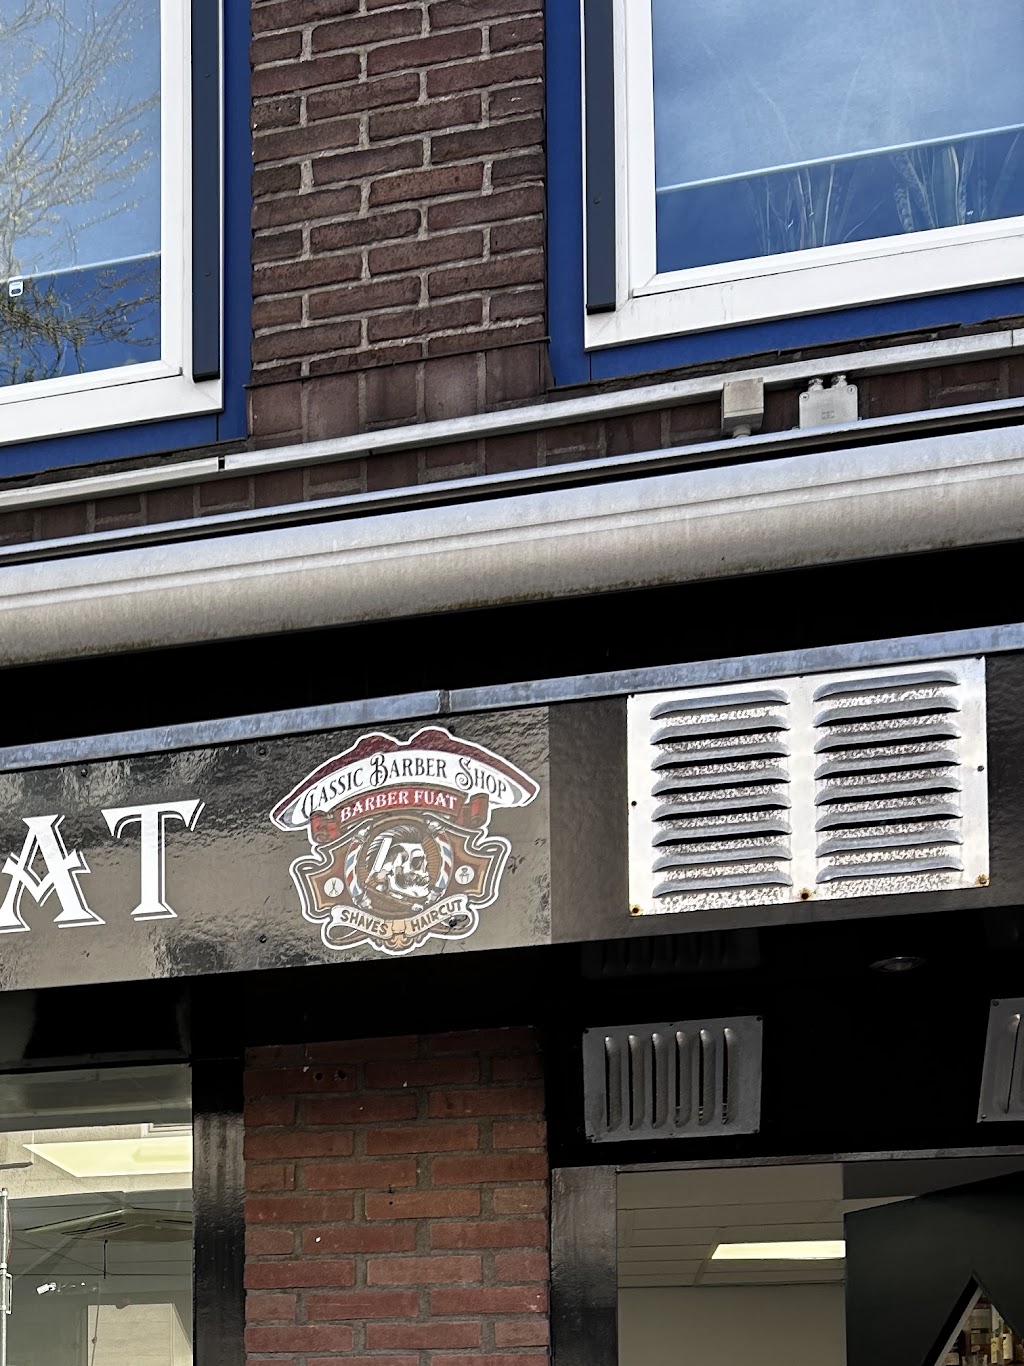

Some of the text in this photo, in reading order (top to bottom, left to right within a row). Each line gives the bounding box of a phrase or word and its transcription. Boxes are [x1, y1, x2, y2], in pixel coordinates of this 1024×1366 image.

[301, 754, 507, 819] CLASSIC BARBER SHOP
[340, 789, 458, 823] BARBER FUAT
[339, 900, 463, 936] SHAVES HAIRCUT
